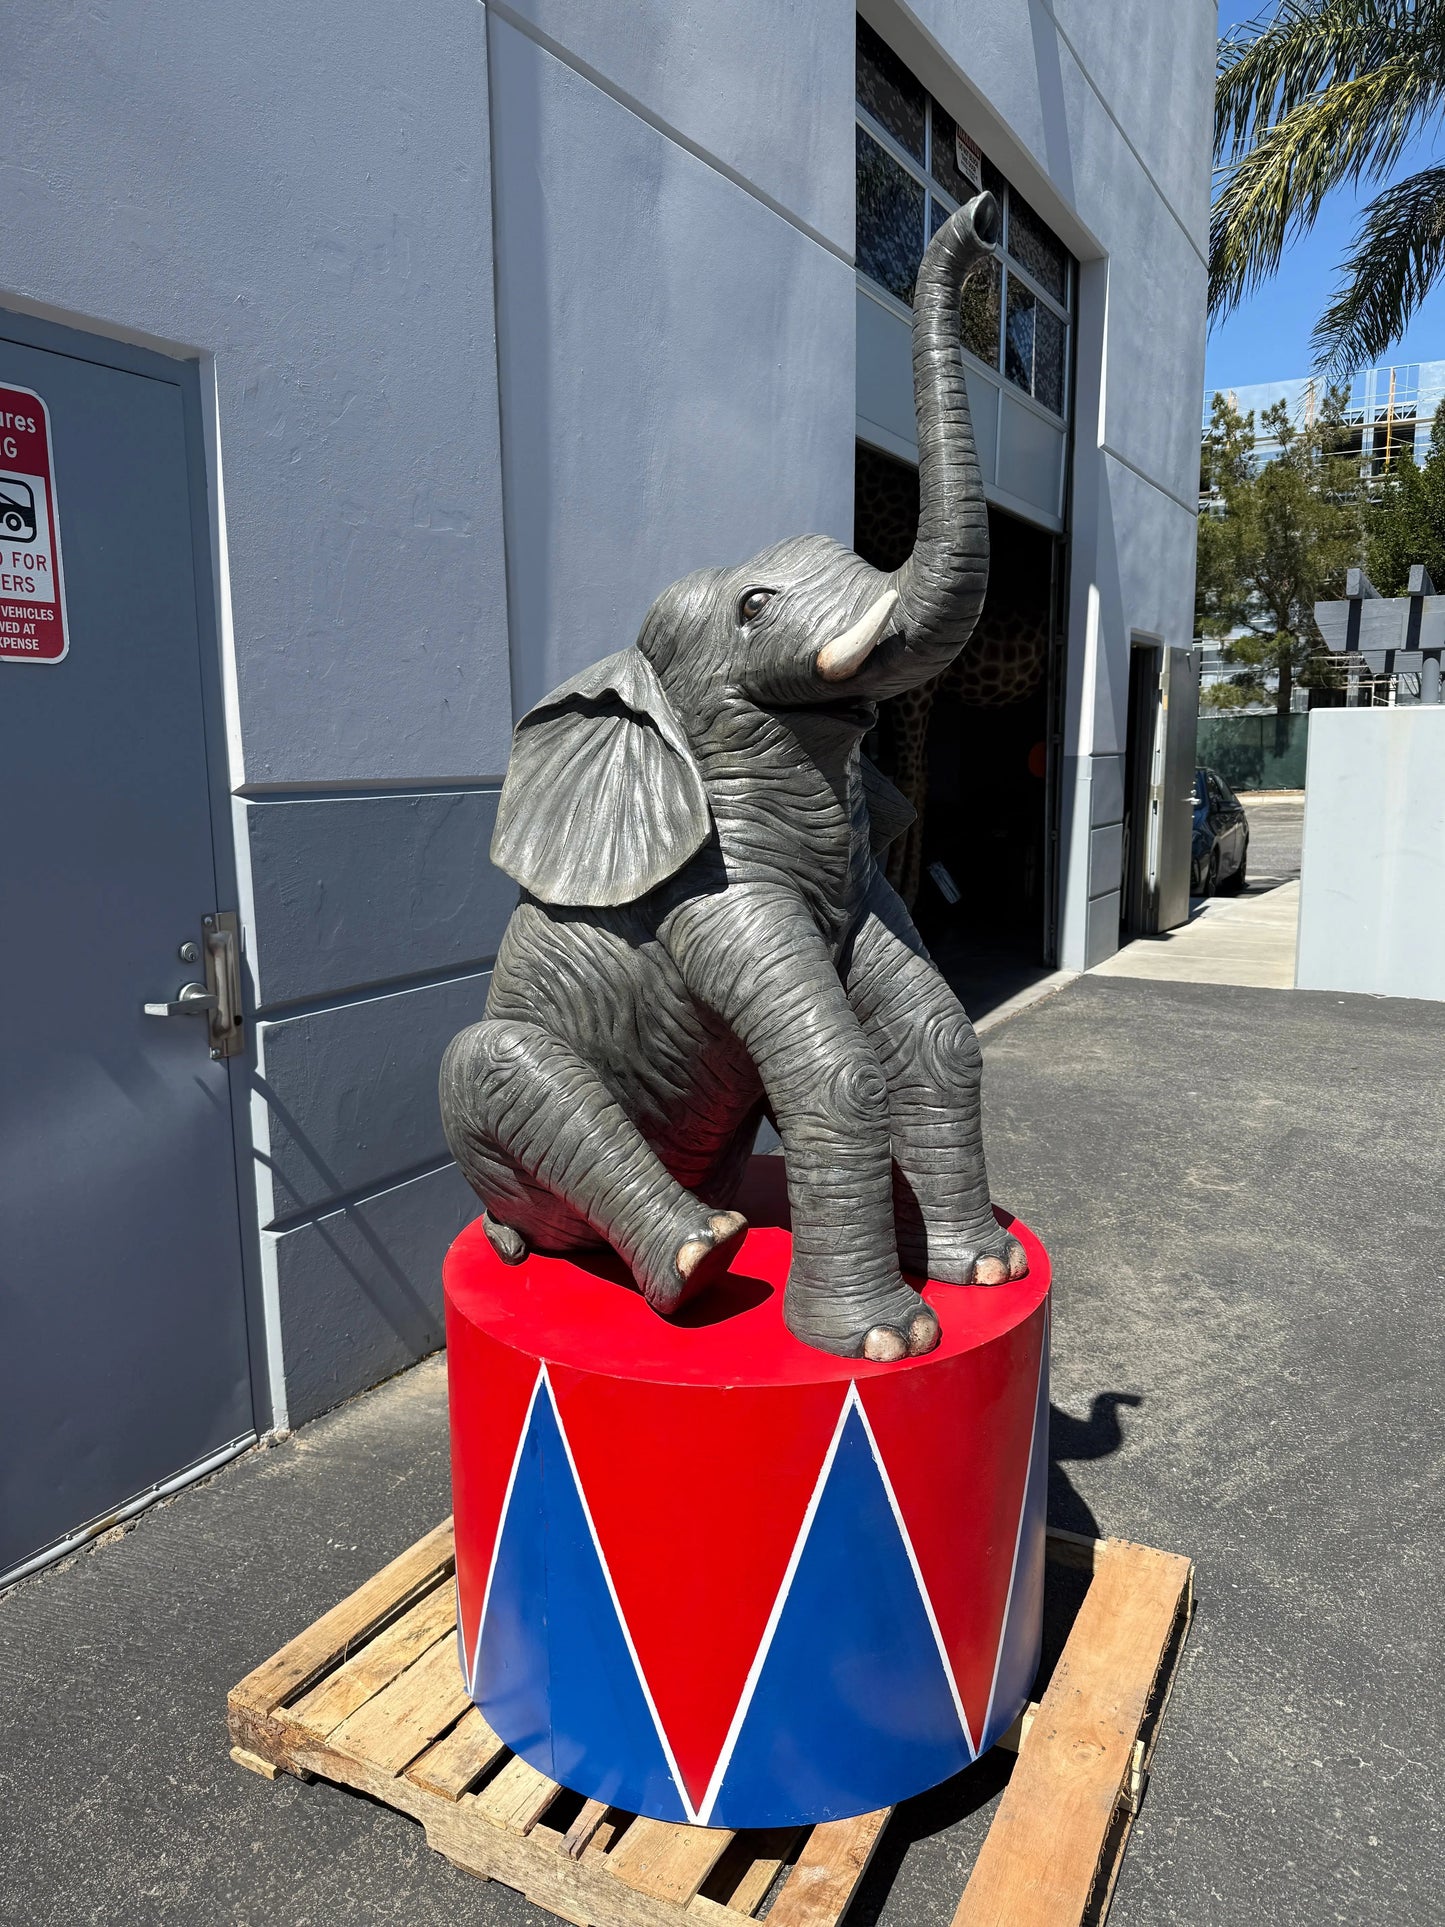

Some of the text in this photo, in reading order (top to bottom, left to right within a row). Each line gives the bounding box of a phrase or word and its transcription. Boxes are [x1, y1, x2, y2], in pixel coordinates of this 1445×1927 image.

[12, 551, 48, 571] FOR
[0, 605, 54, 621] VEHICLES
[23, 622, 36, 635] AT
